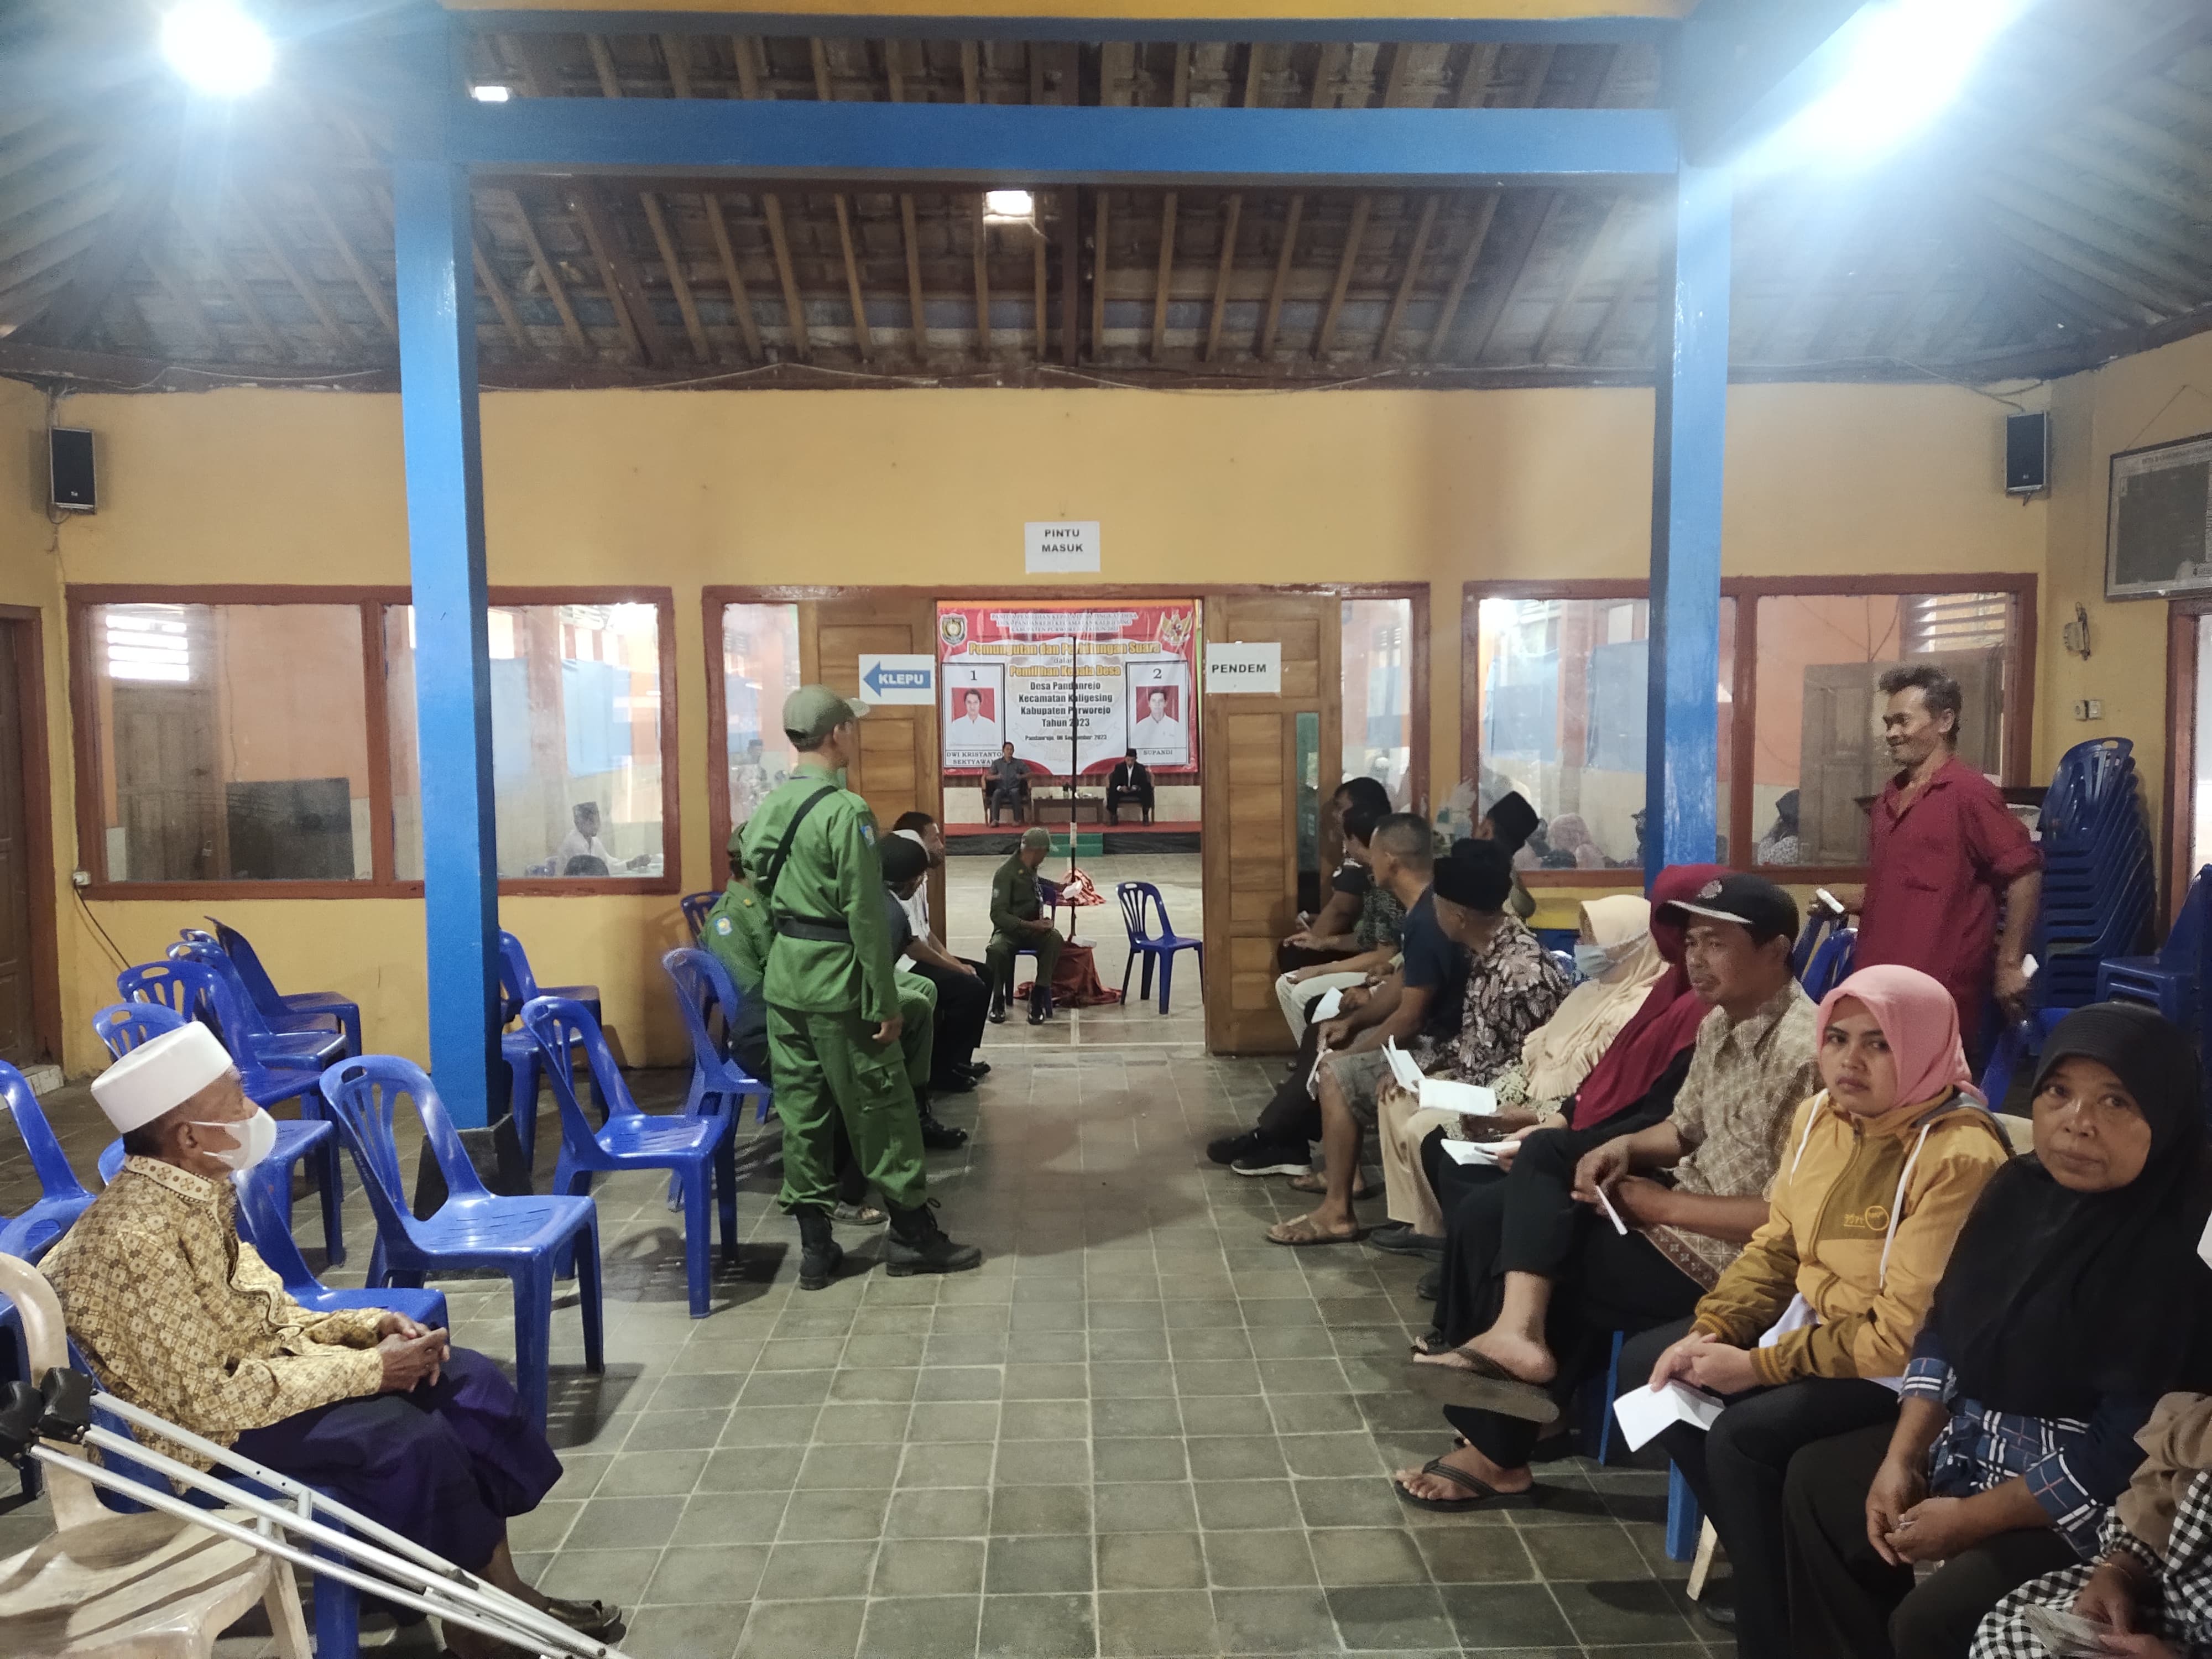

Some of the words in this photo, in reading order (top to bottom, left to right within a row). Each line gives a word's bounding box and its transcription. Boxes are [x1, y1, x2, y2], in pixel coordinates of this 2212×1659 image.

[1045, 529, 1079, 537] PINTU
[1042, 544, 1083, 552] MASUK
[968, 643, 1037, 656] Pemungutan
[1039, 643, 1060, 655] dan
[1129, 641, 1160, 654] Suara
[1010, 665, 1060, 677] Pemilihan
[1095, 665, 1121, 676] Desa
[1212, 664, 1266, 673] PENDEM
[971, 670, 977, 681] 1
[1153, 668, 1162, 679] 2
[878, 674, 924, 685] KLEPU
[1053, 681, 1100, 690] Pandanrejo
[1021, 706, 1066, 715] Kabupaten
[1068, 706, 1111, 714] Prworejo
[1068, 718, 1090, 727] 223
